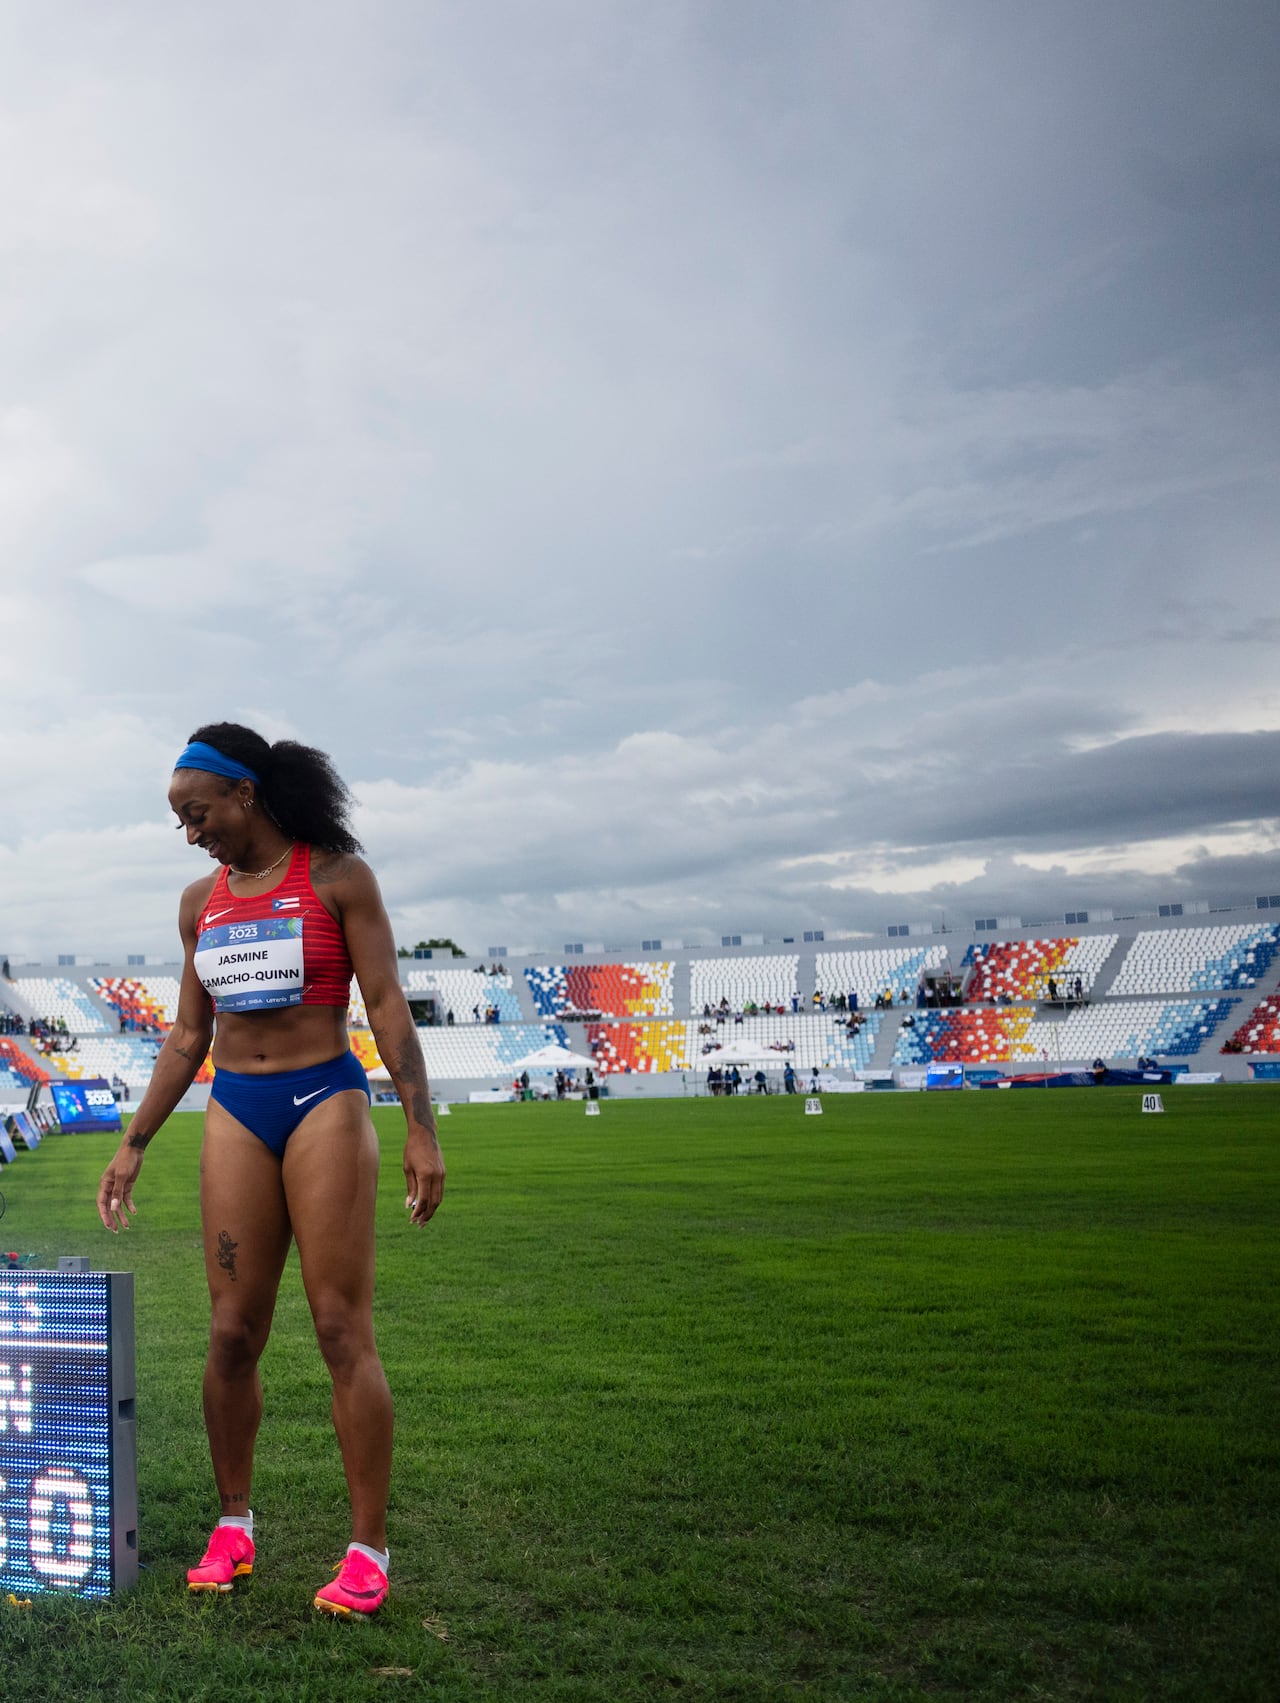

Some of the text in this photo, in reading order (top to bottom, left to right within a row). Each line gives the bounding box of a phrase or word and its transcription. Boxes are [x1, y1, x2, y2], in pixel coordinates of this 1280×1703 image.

[228, 927, 258, 940] 2023
[218, 950, 268, 966] JASMINE
[1144, 1096, 1156, 1110] 40
